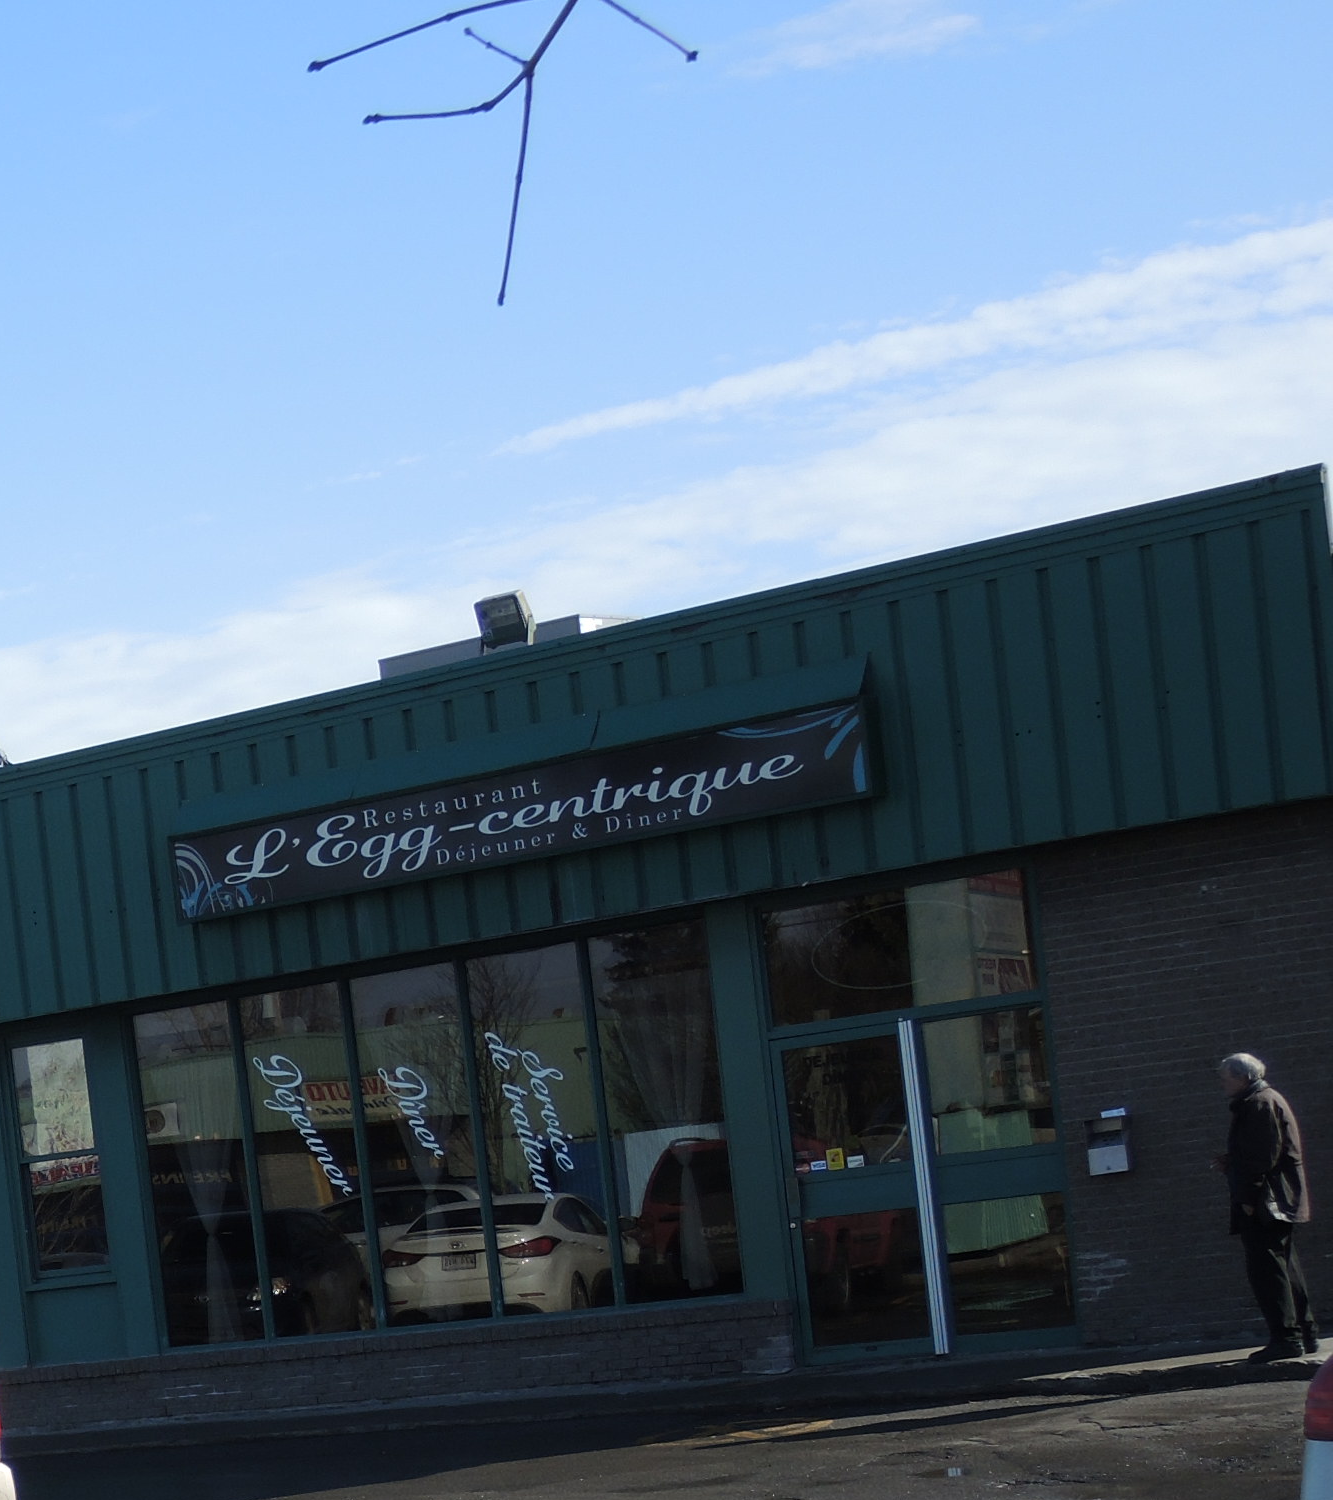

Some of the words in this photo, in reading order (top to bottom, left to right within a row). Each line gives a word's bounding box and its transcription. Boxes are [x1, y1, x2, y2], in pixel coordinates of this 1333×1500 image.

[363, 778, 543, 828] Restaurant
[435, 830, 557, 866] Déjeuner
[571, 822, 589, 840] &
[605, 806, 684, 834] Dîner
[252, 1055, 353, 1197] Déjeuner
[378, 1066, 444, 1159] Dîner
[484, 1031, 518, 1072] de
[502, 1081, 555, 1201] traiteur
[517, 1048, 574, 1173] Service
